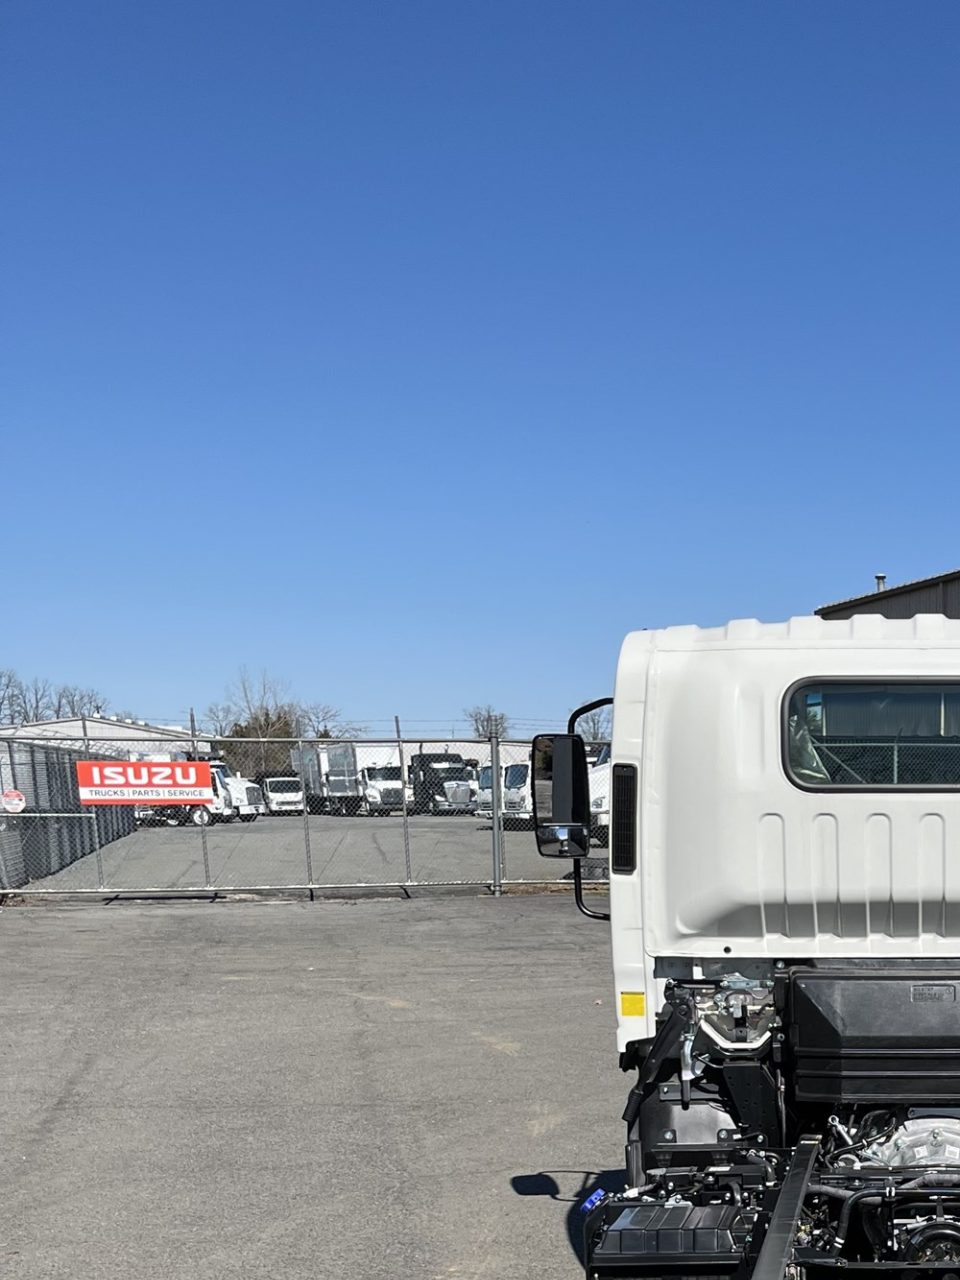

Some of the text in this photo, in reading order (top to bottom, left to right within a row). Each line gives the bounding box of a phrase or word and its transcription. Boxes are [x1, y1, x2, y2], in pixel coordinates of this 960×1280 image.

[91, 766, 197, 785] ISUZU
[88, 789, 205, 797] TRUCKS PARTS SERVICE
